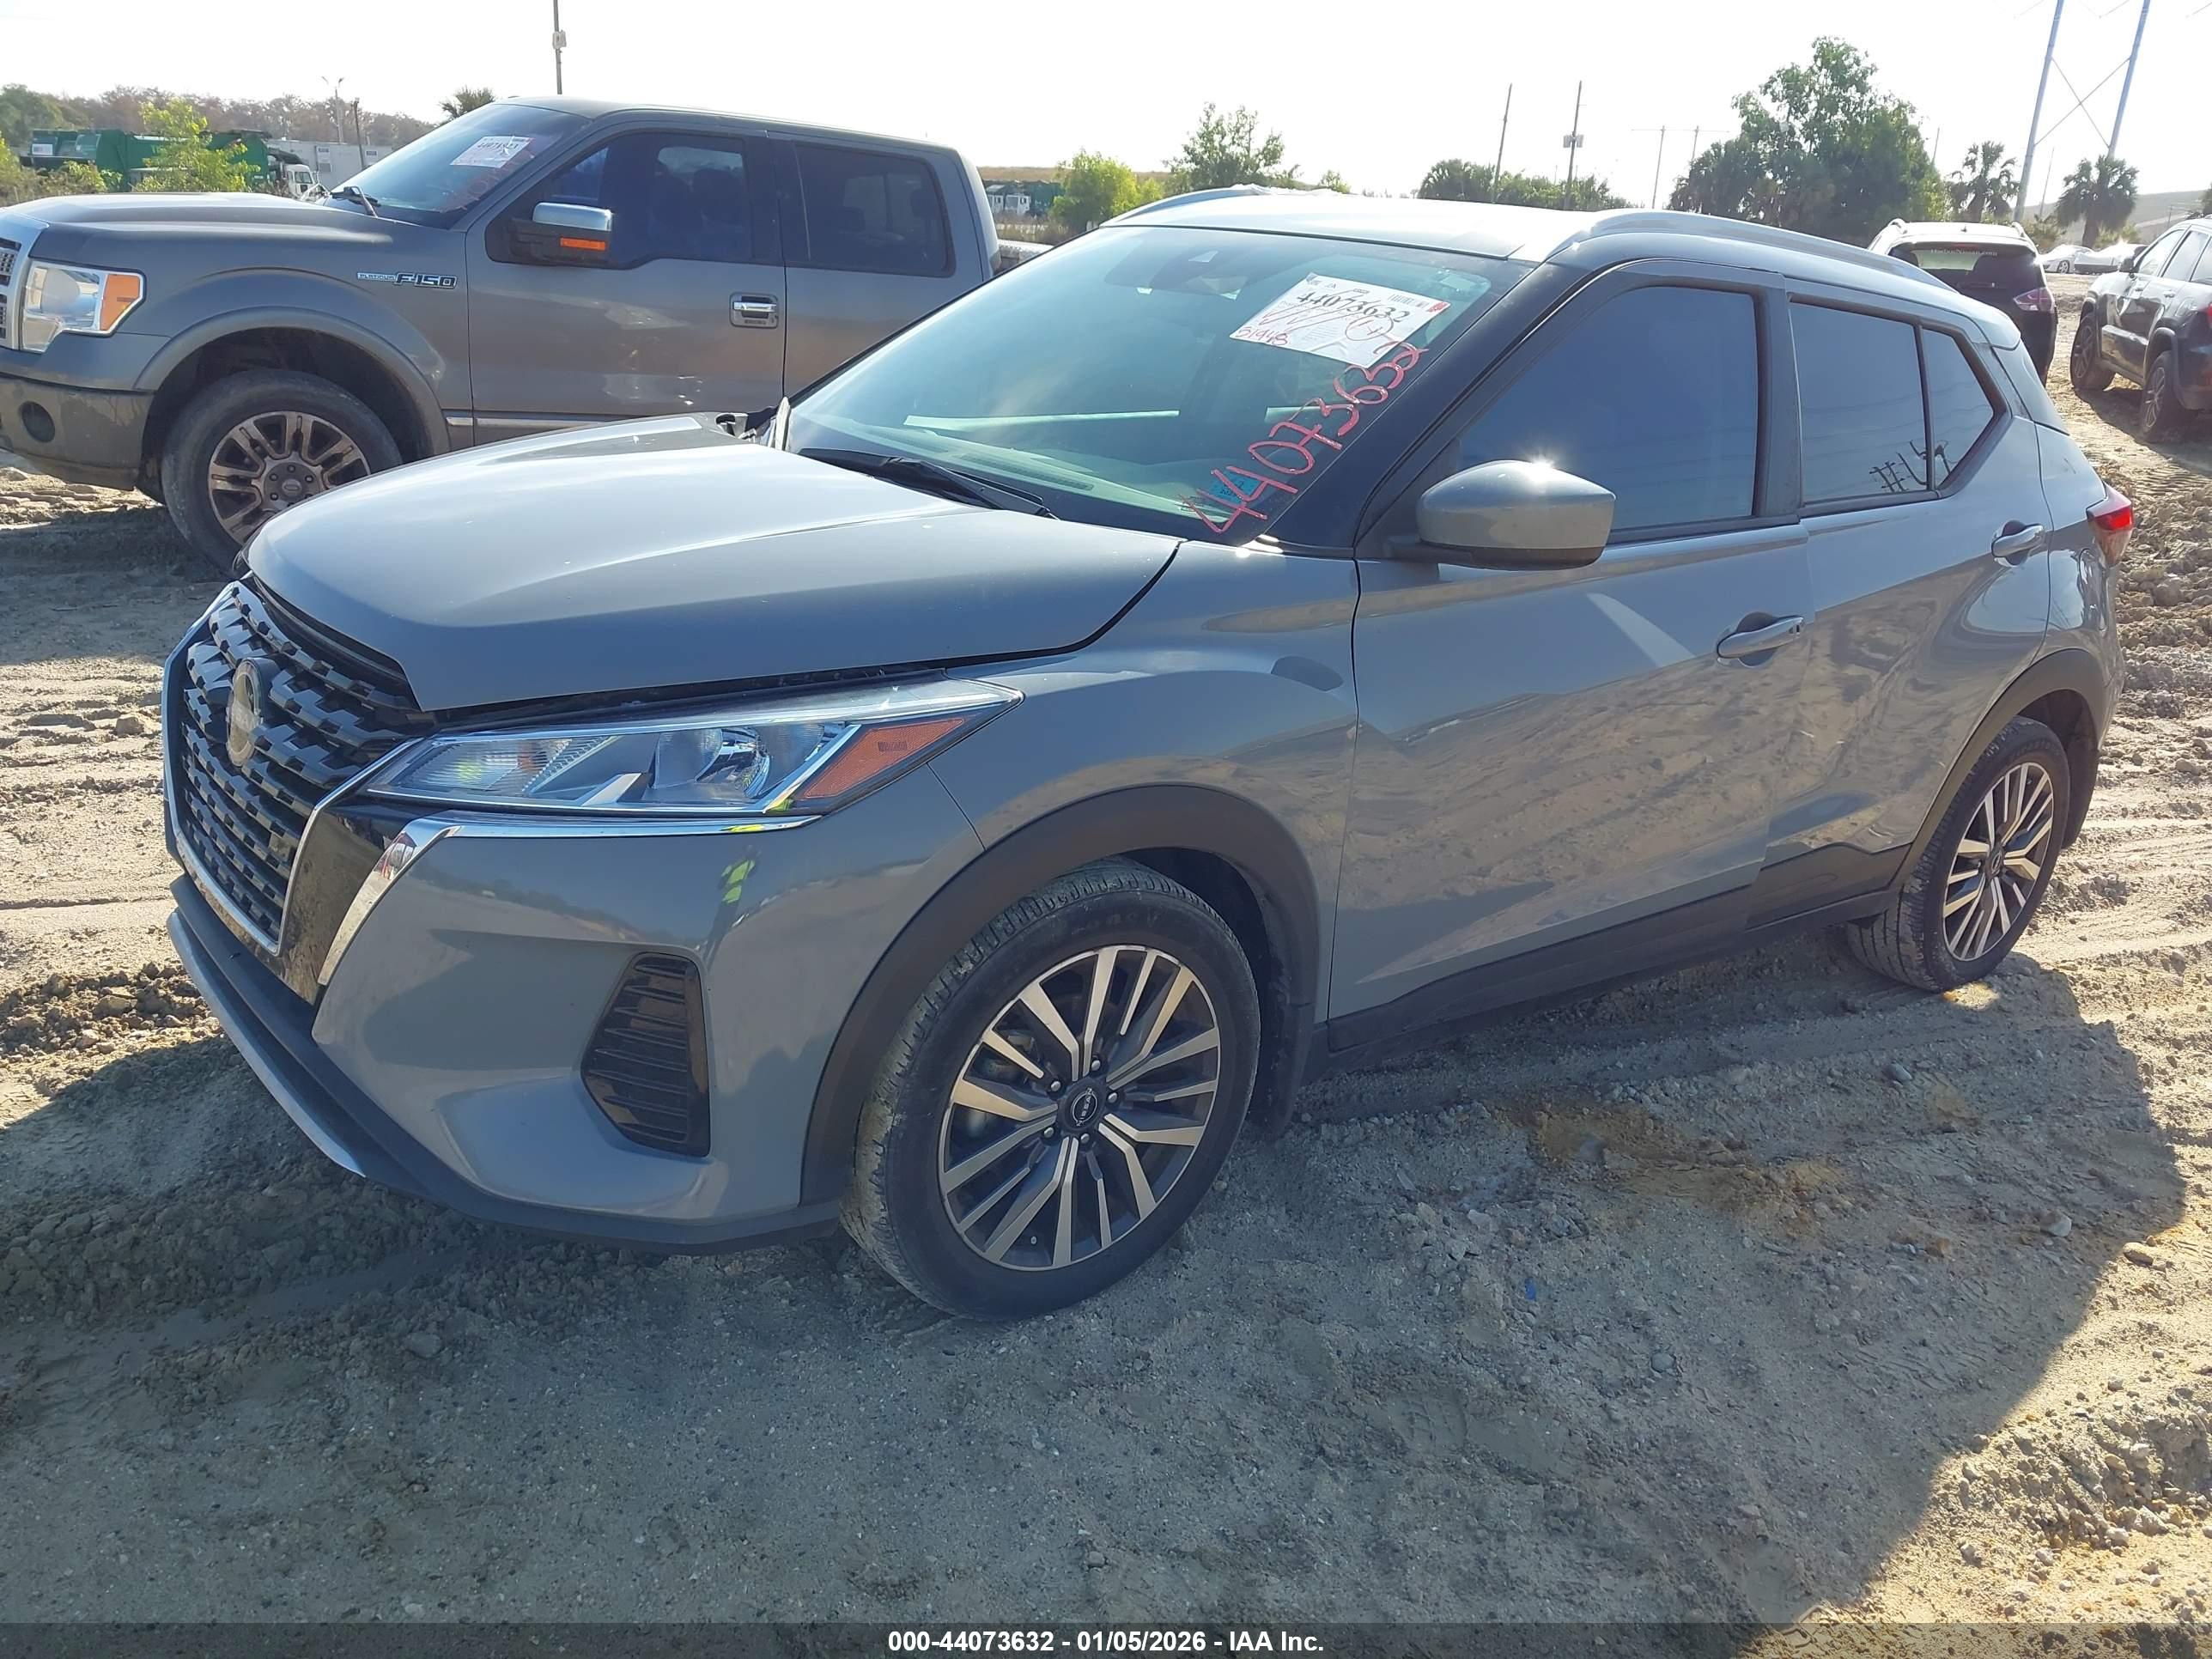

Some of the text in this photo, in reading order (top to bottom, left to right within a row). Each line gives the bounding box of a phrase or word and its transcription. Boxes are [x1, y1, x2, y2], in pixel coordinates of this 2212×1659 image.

[1297, 290, 1410, 323] 44073632
[1182, 341, 1429, 534] 44073632
[1075, 1087, 1092, 1127] NISSAN
